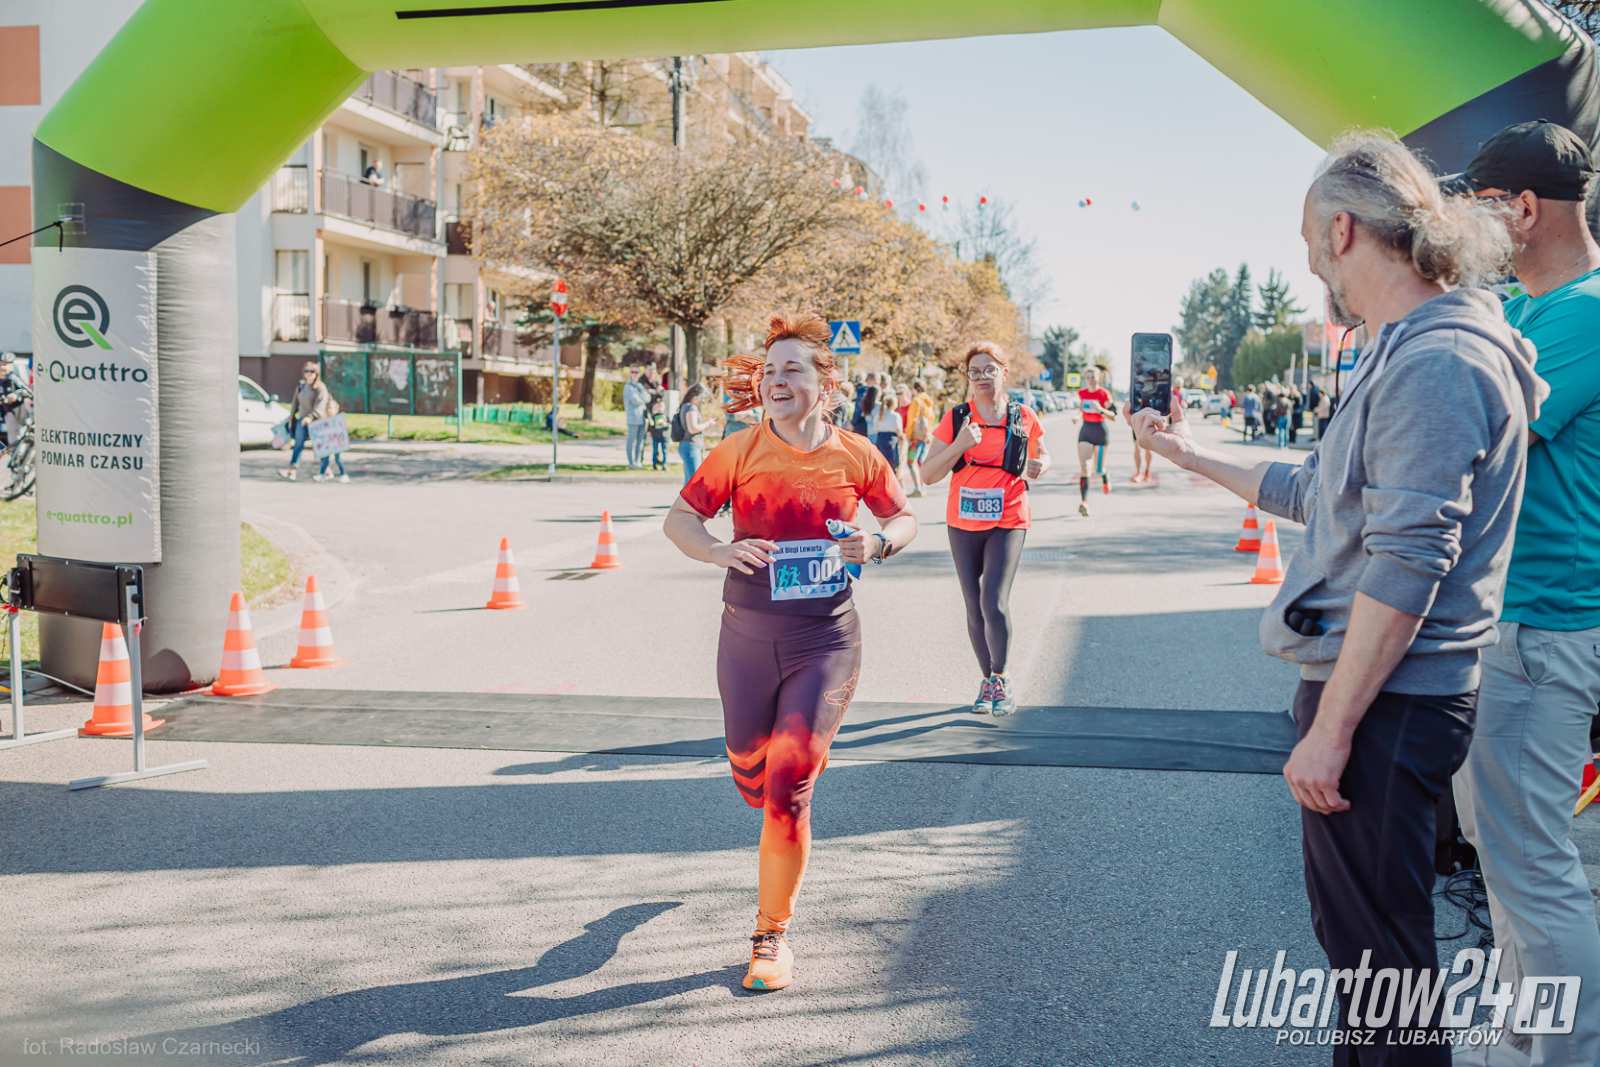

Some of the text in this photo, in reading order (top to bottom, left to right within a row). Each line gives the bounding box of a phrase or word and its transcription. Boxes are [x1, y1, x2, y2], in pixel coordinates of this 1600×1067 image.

[41, 428, 143, 448] ELEKTRONICZNY
[41, 450, 144, 471] POMIAR CZASU
[977, 498, 1001, 512] 083
[46, 510, 133, 528] e-quattro.pl
